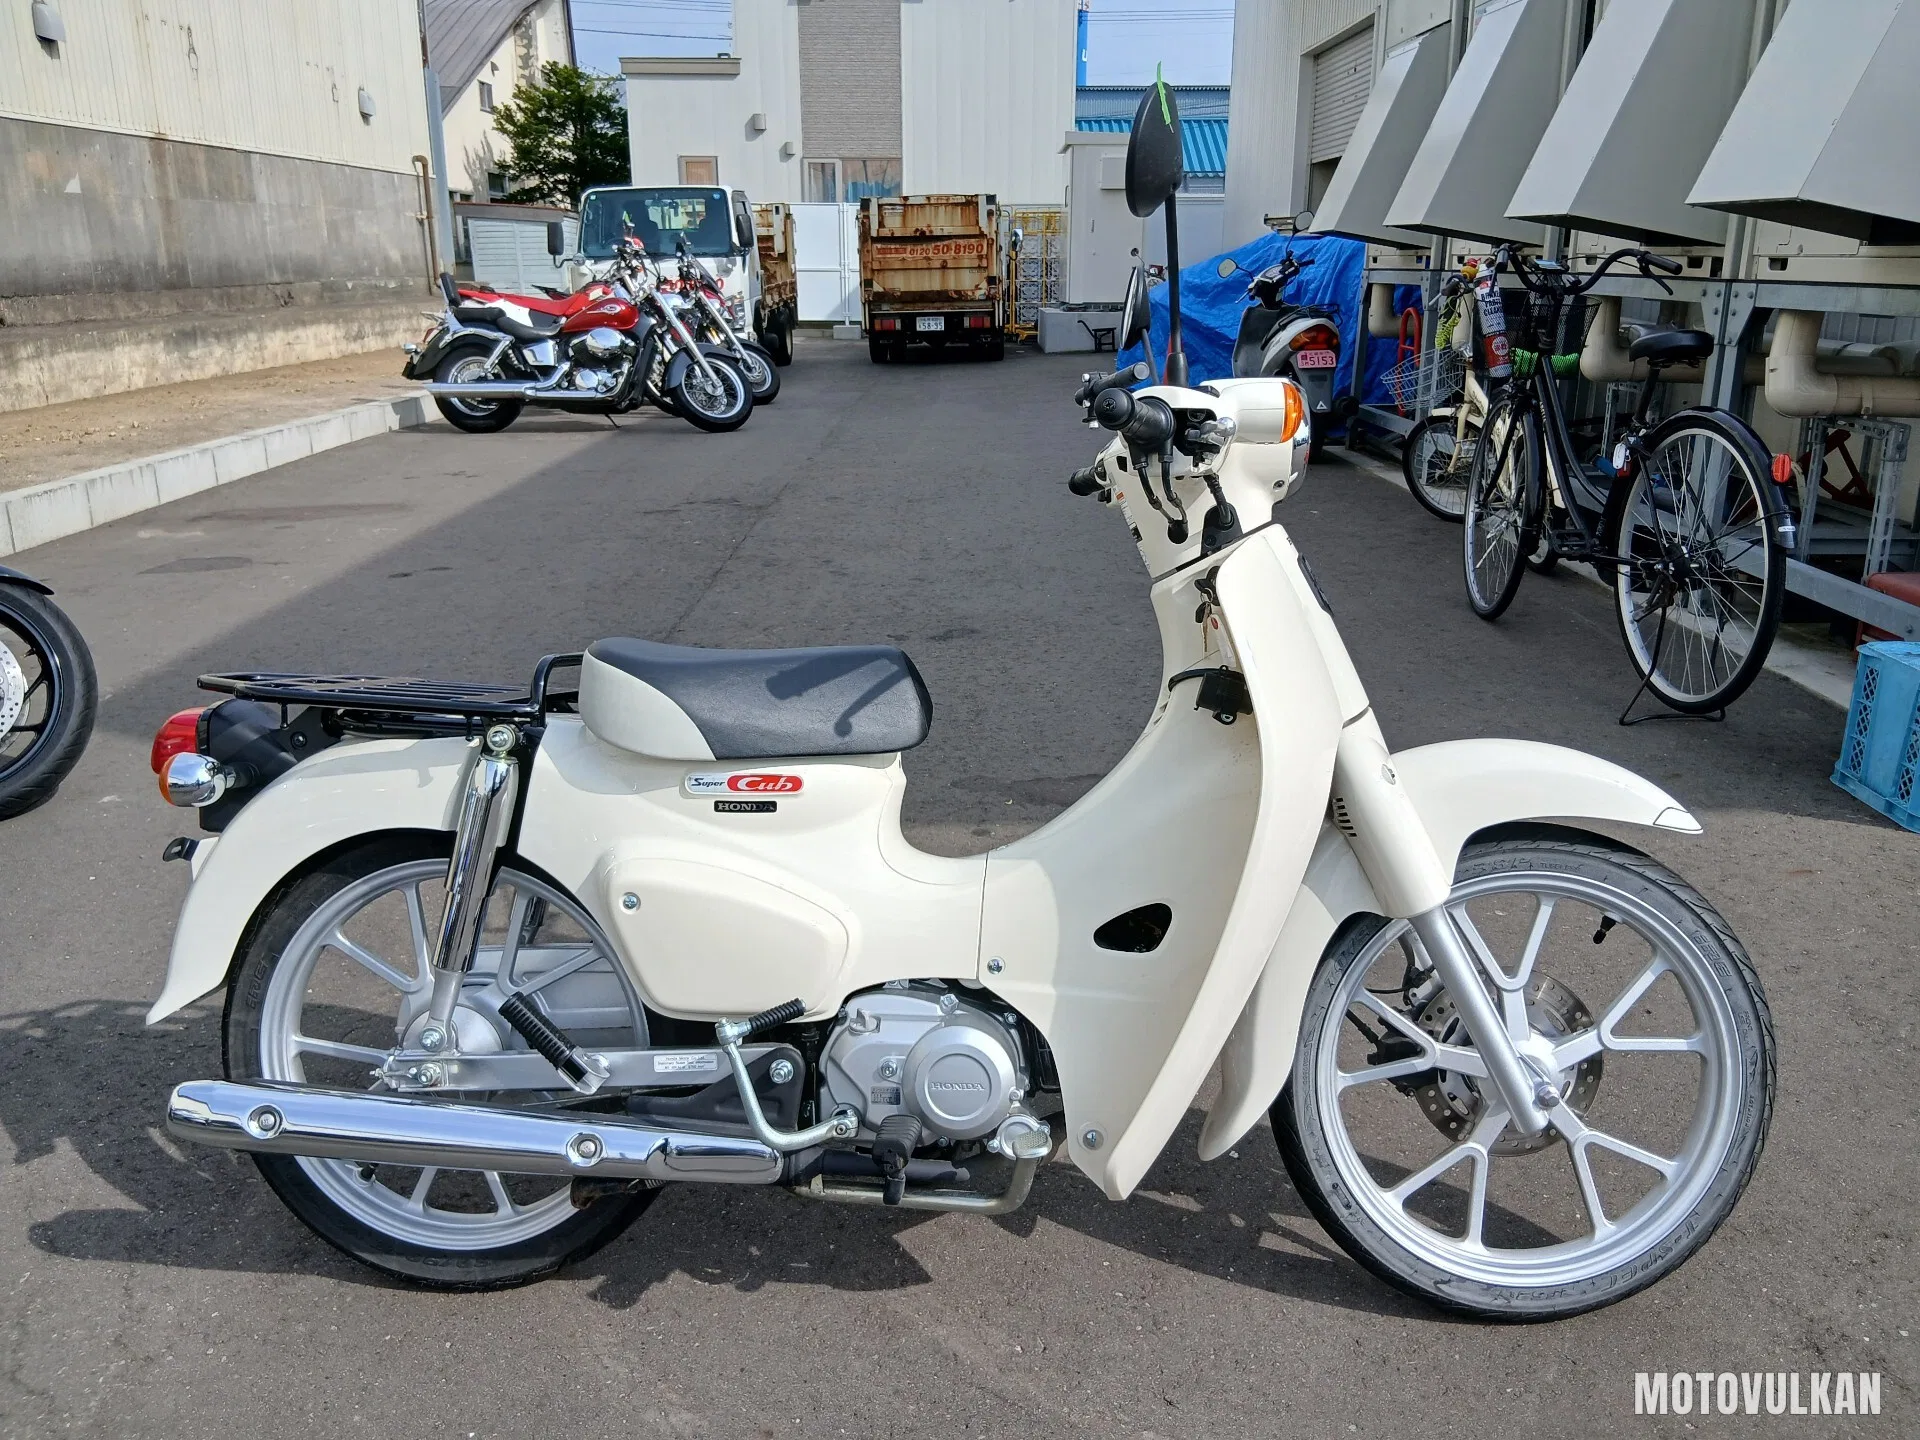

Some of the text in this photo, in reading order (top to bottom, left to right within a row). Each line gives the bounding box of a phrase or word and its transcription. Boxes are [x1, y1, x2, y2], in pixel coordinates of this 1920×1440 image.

[909, 247, 931, 256] 0120
[1309, 356, 1334, 366] 5153
[691, 776, 793, 791] Super Cub
[717, 802, 775, 811] HONDA
[930, 1081, 985, 1091] HONDA
